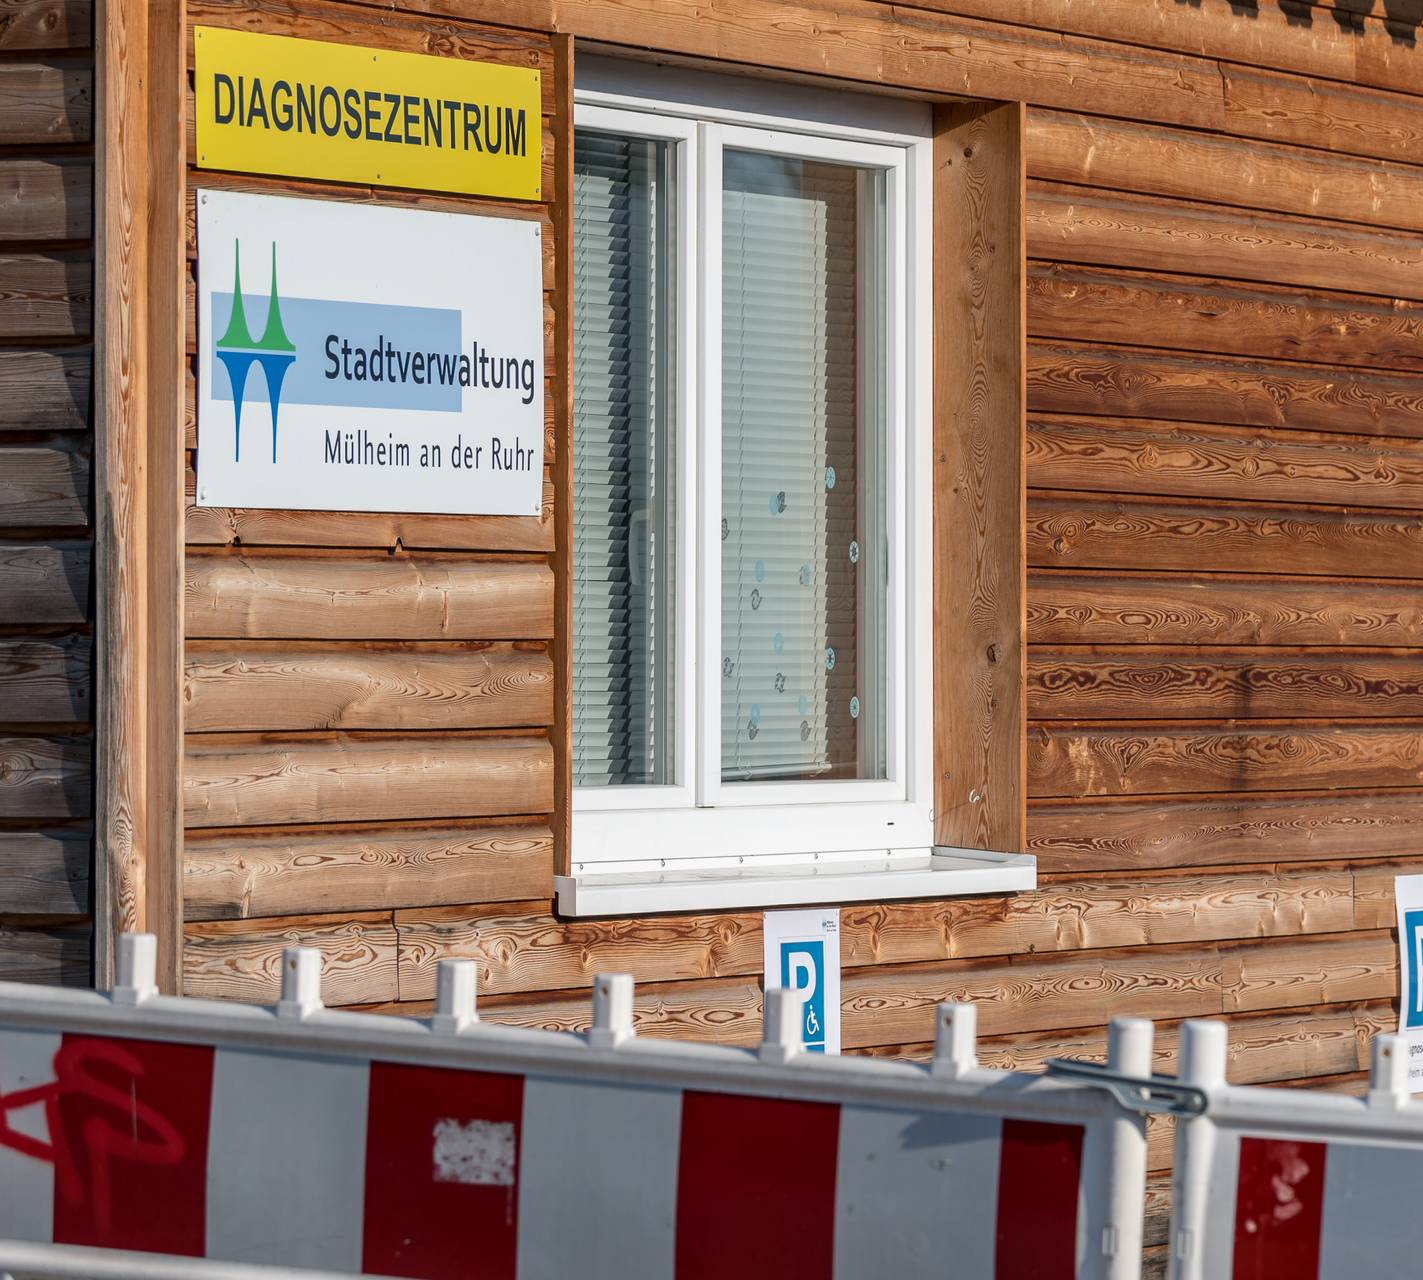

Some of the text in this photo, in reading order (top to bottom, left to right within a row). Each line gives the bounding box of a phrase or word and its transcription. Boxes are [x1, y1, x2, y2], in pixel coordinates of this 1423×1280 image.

[214, 73, 526, 157] DIAGNOSEZENTRUM
[325, 334, 535, 404] Stadtverwaltung
[324, 429, 534, 471] Mülheim an der Ruhr
